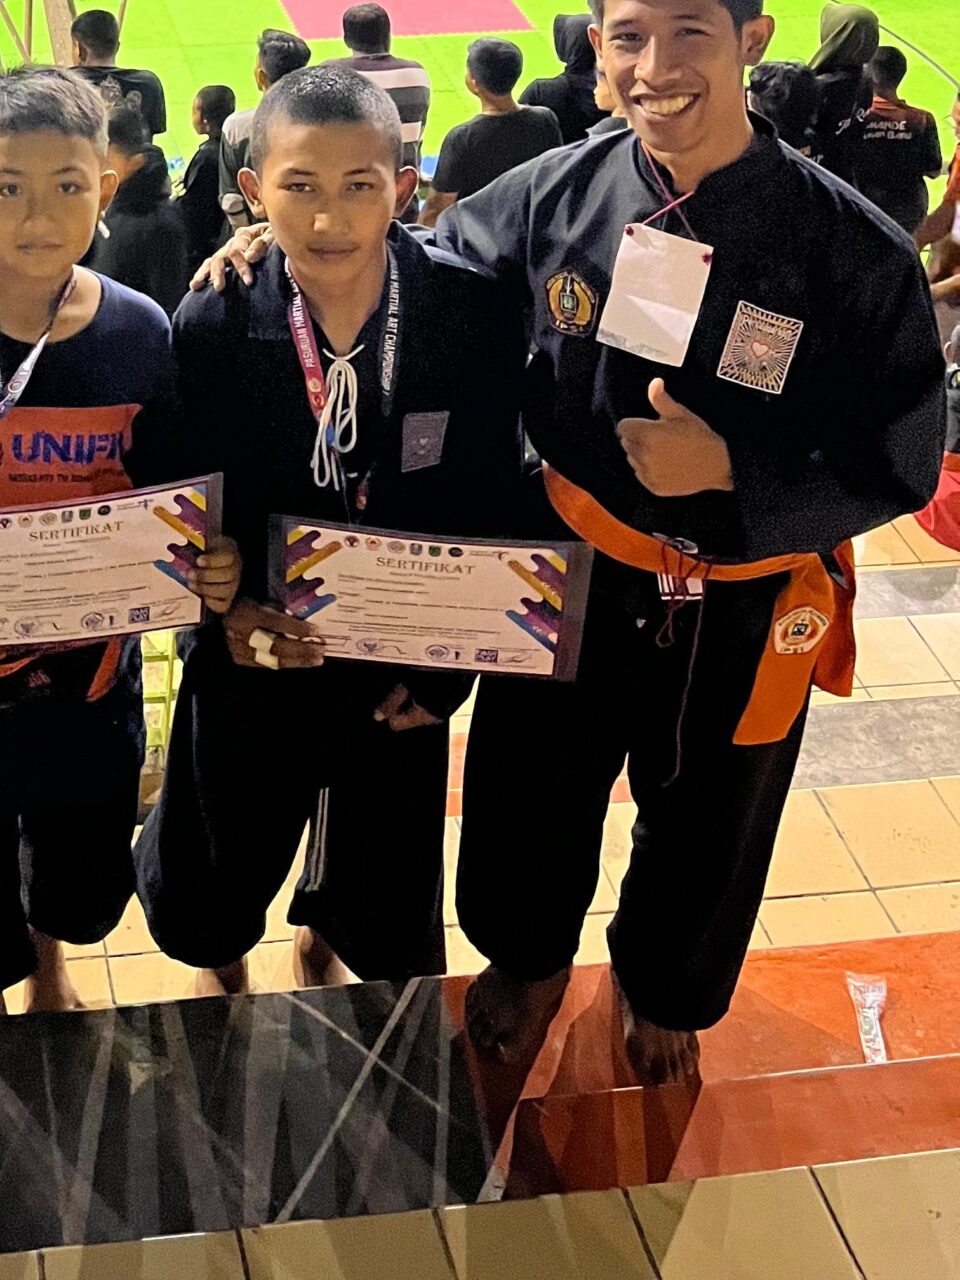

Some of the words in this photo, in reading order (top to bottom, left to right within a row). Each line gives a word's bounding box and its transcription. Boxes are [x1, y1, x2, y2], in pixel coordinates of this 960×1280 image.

[292, 293, 305, 327] MARTIAL
[388, 280, 400, 315] MARTIAL
[387, 316, 399, 333] ART
[296, 327, 316, 368] PASURUAN
[382, 333, 397, 390] CHAMPIONSHIP
[28, 521, 125, 542] SERTIFIKAT
[375, 556, 477, 575] SERTIFIKAT
